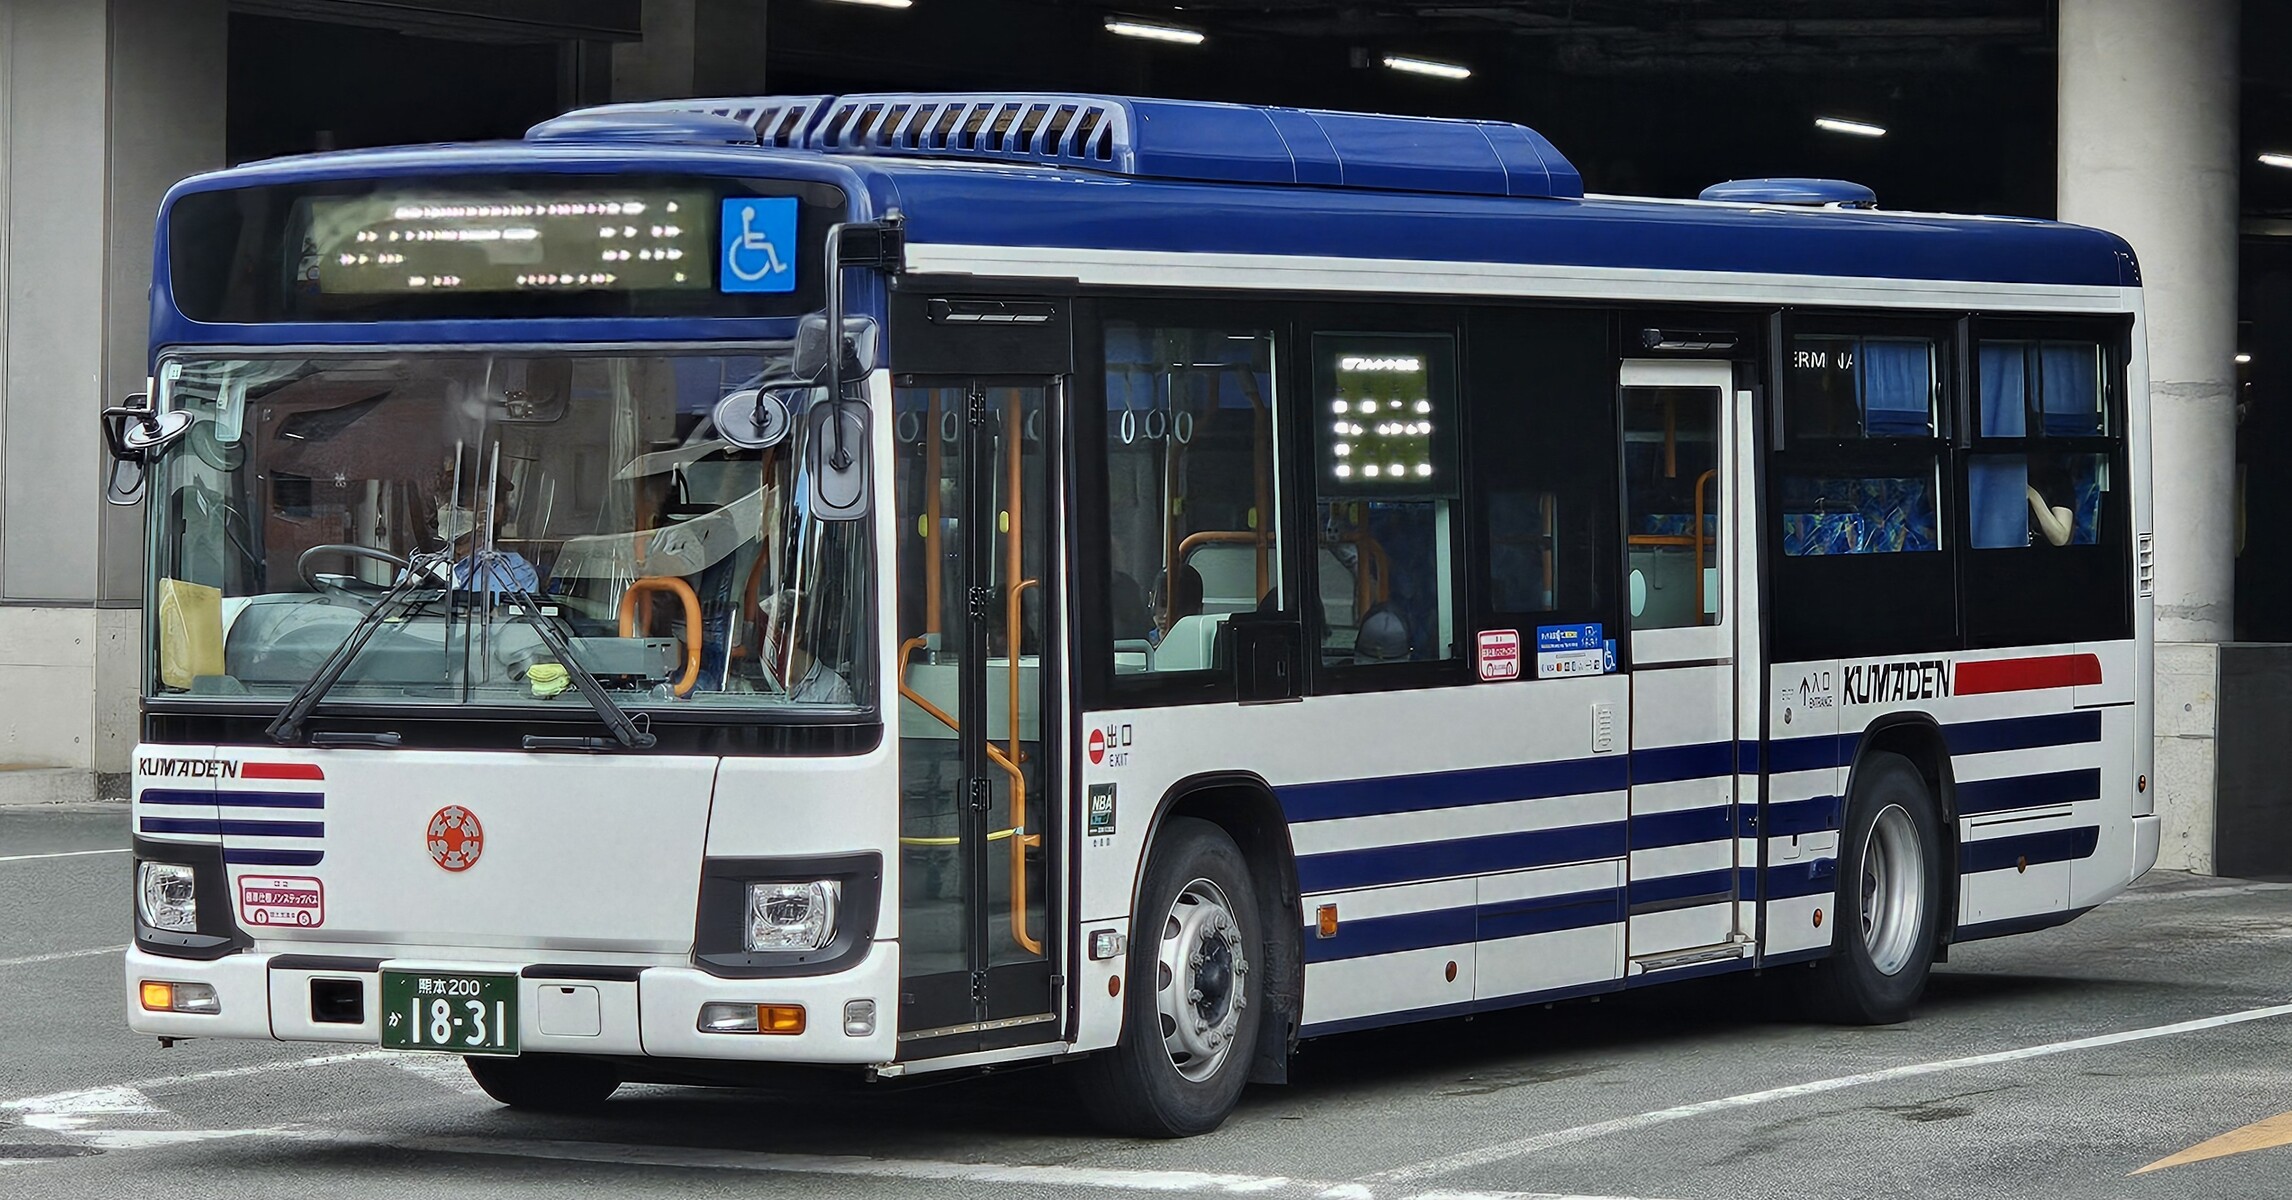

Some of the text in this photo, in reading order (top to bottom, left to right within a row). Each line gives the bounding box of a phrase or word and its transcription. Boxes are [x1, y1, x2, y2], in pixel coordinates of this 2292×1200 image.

[1811, 672, 1830, 693] 入口
[1843, 659, 1951, 705] KUMADEN
[1106, 723, 1132, 748] 出口
[139, 757, 238, 778] KUMADEN
[1109, 752, 1129, 767] EXIT
[1092, 794, 1112, 811] NBA
[388, 997, 505, 1047] か 18-31
